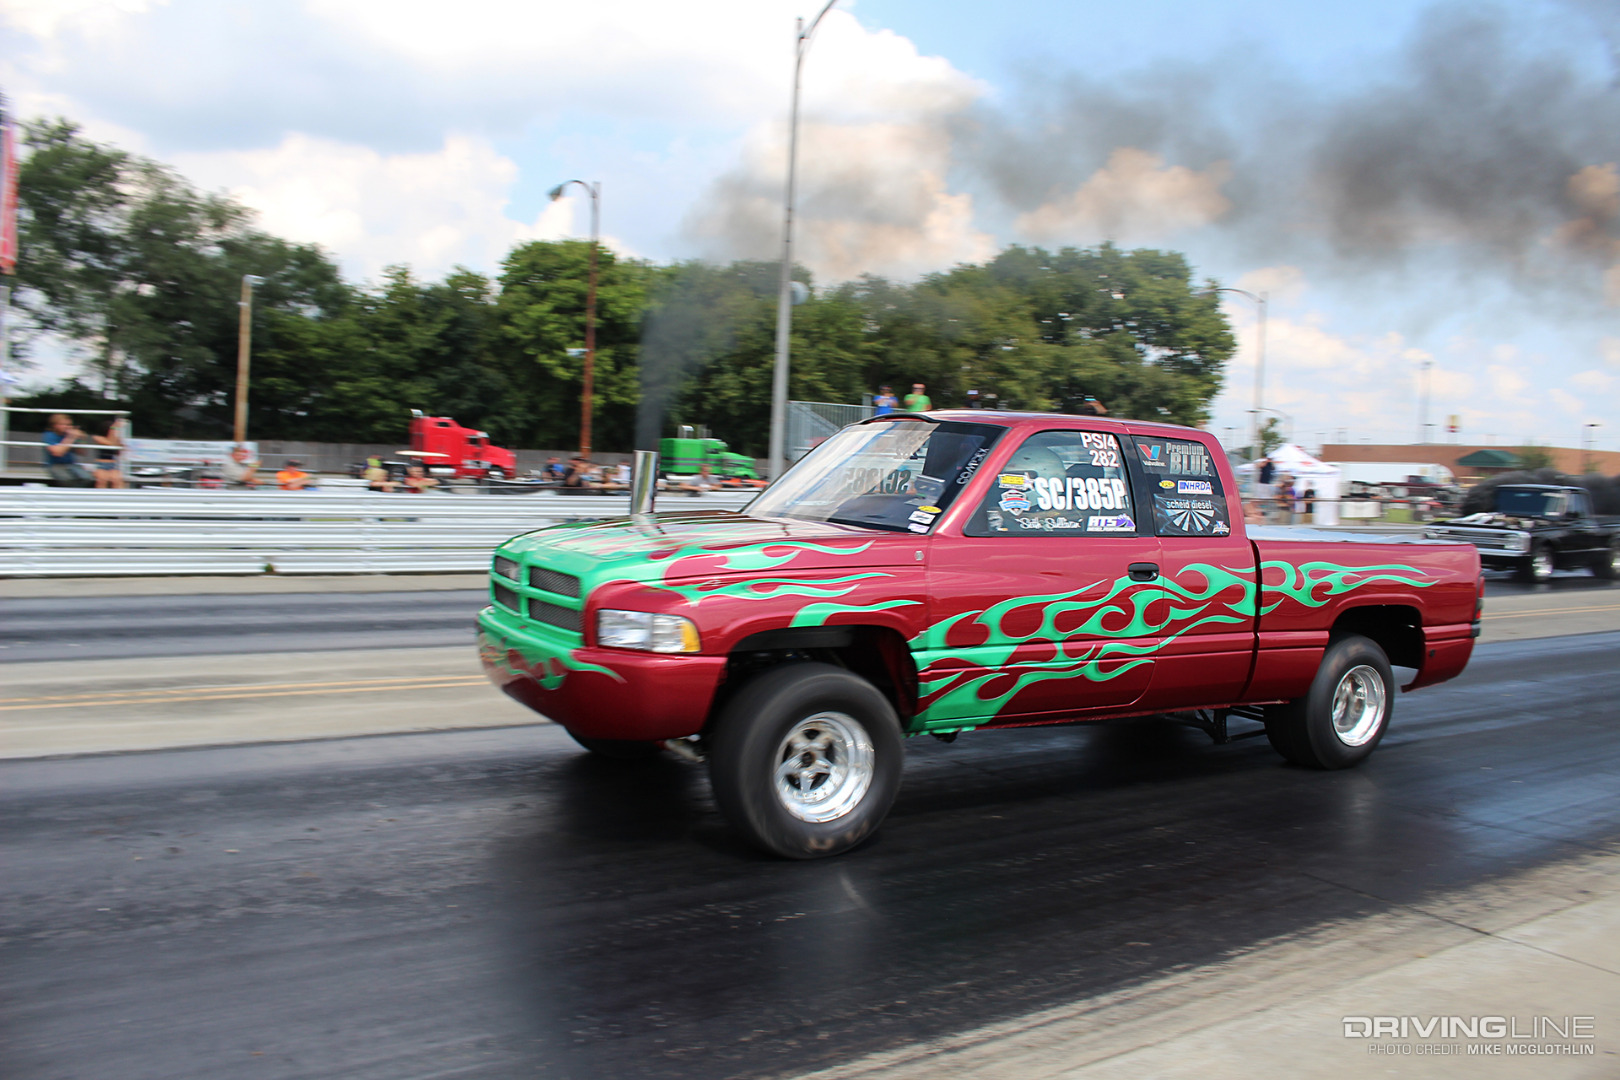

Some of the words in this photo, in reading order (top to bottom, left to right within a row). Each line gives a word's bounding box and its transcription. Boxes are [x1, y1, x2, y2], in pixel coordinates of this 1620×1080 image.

[1080, 432, 1118, 450] PS/4
[1166, 442, 1204, 456] Premium
[1089, 449, 1120, 467] 282
[1170, 452, 1210, 476] BLUE
[1034, 477, 1125, 510] SC/385P
[1183, 481, 1211, 491] NHRDA
[1166, 500, 1190, 508] scheid
[1191, 500, 1213, 509] diesel
[1089, 516, 1117, 527] ATS
